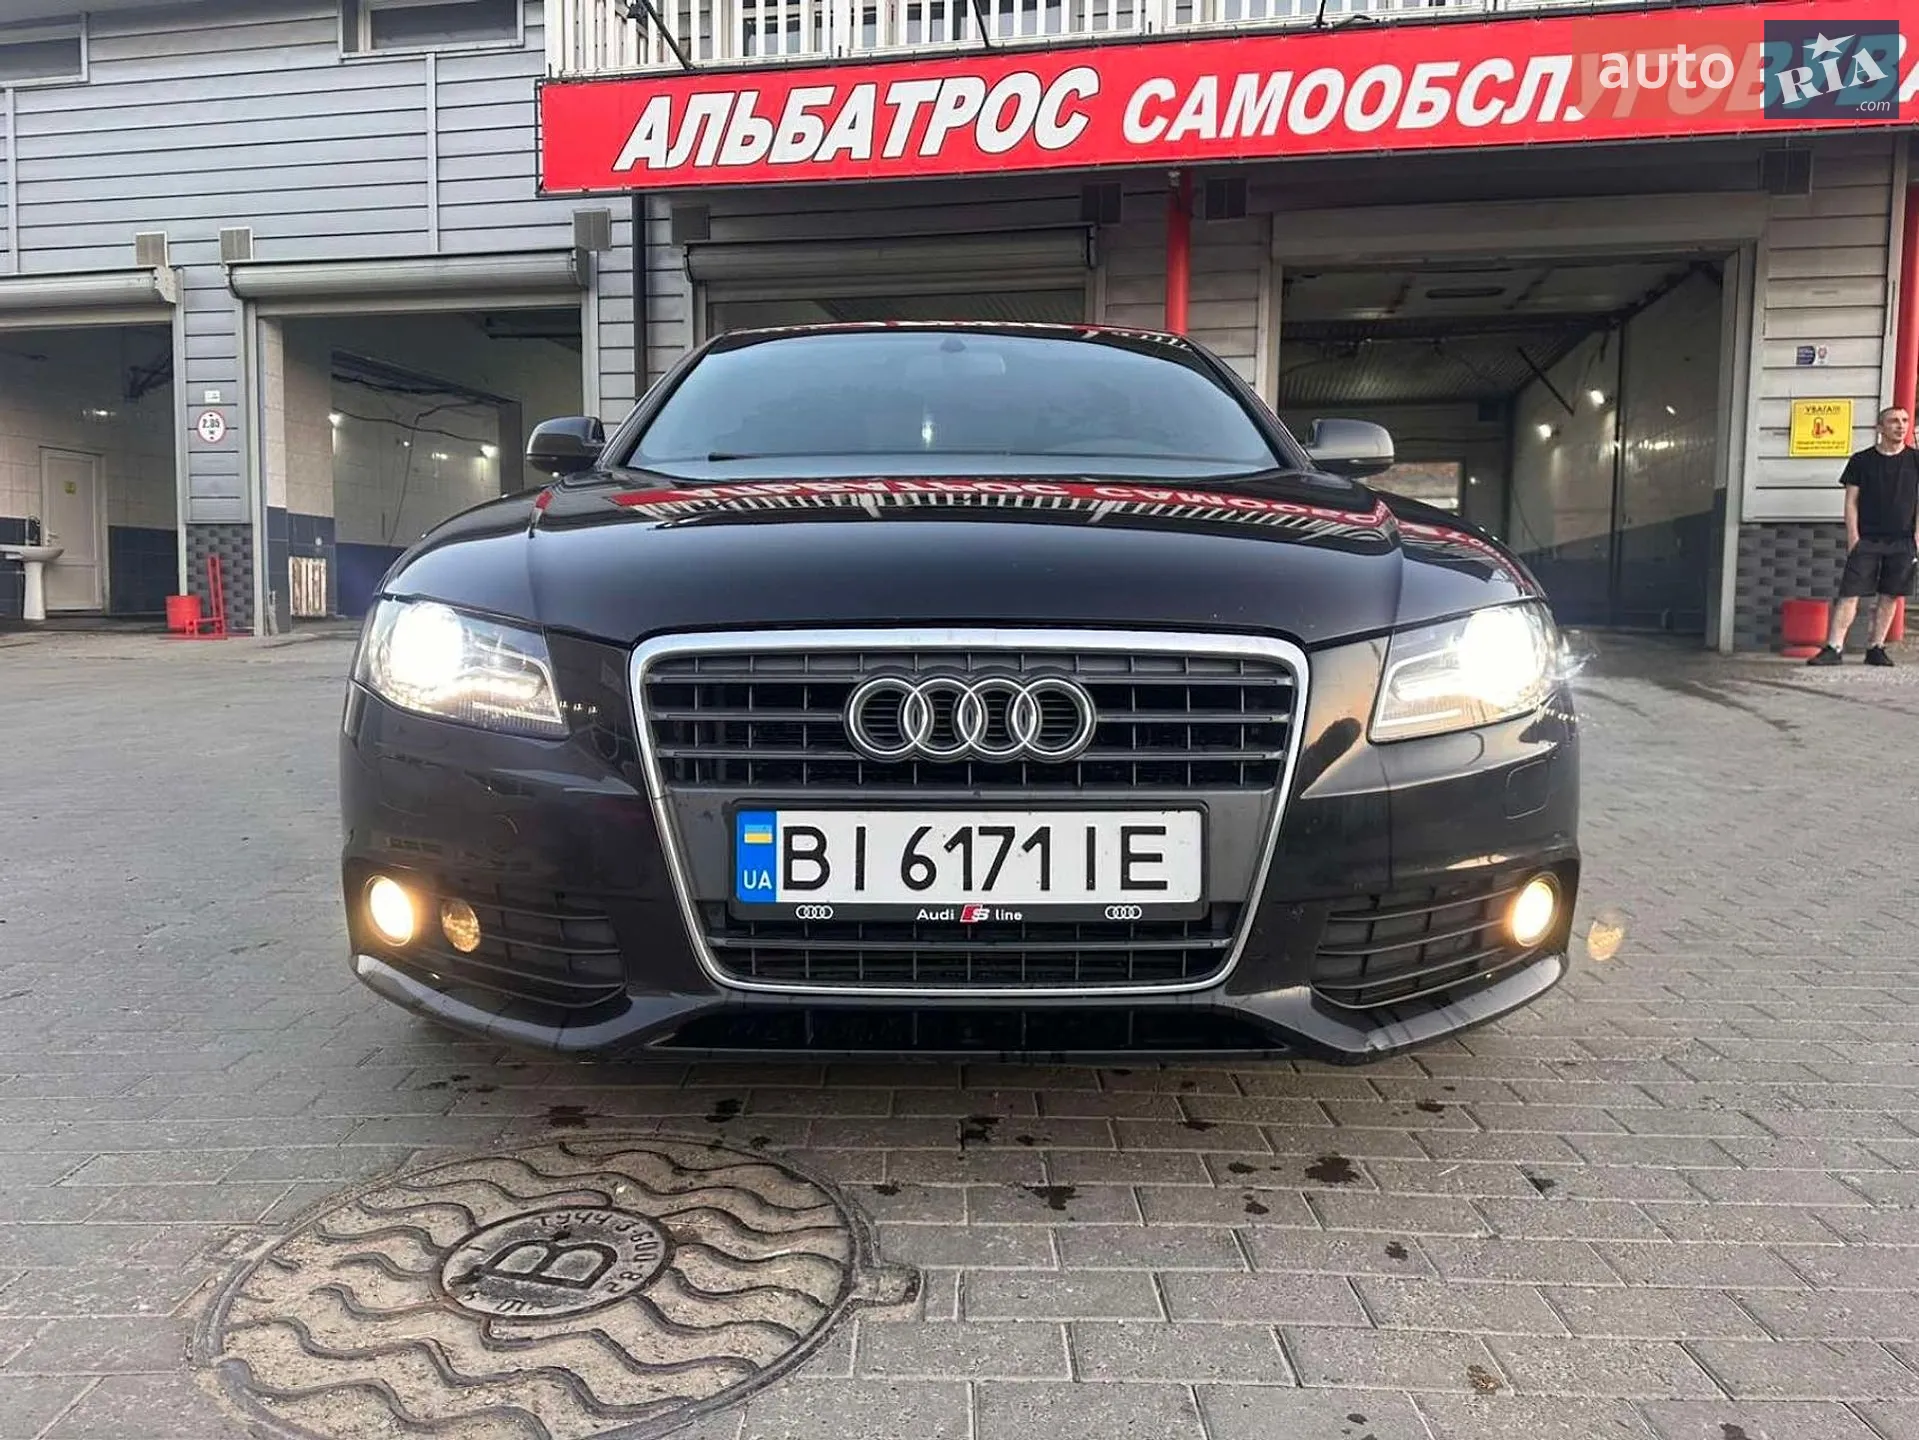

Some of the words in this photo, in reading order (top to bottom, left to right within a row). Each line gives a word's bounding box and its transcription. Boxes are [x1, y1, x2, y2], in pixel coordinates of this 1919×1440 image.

[612, 66, 1100, 172] АЛЬБАТРОС
[743, 869, 772, 890] UA
[782, 825, 866, 891] BI
[900, 825, 1050, 891] 6171
[1086, 825, 1168, 890] IE
[916, 908, 955, 921] Audi
[995, 908, 1023, 921] line
